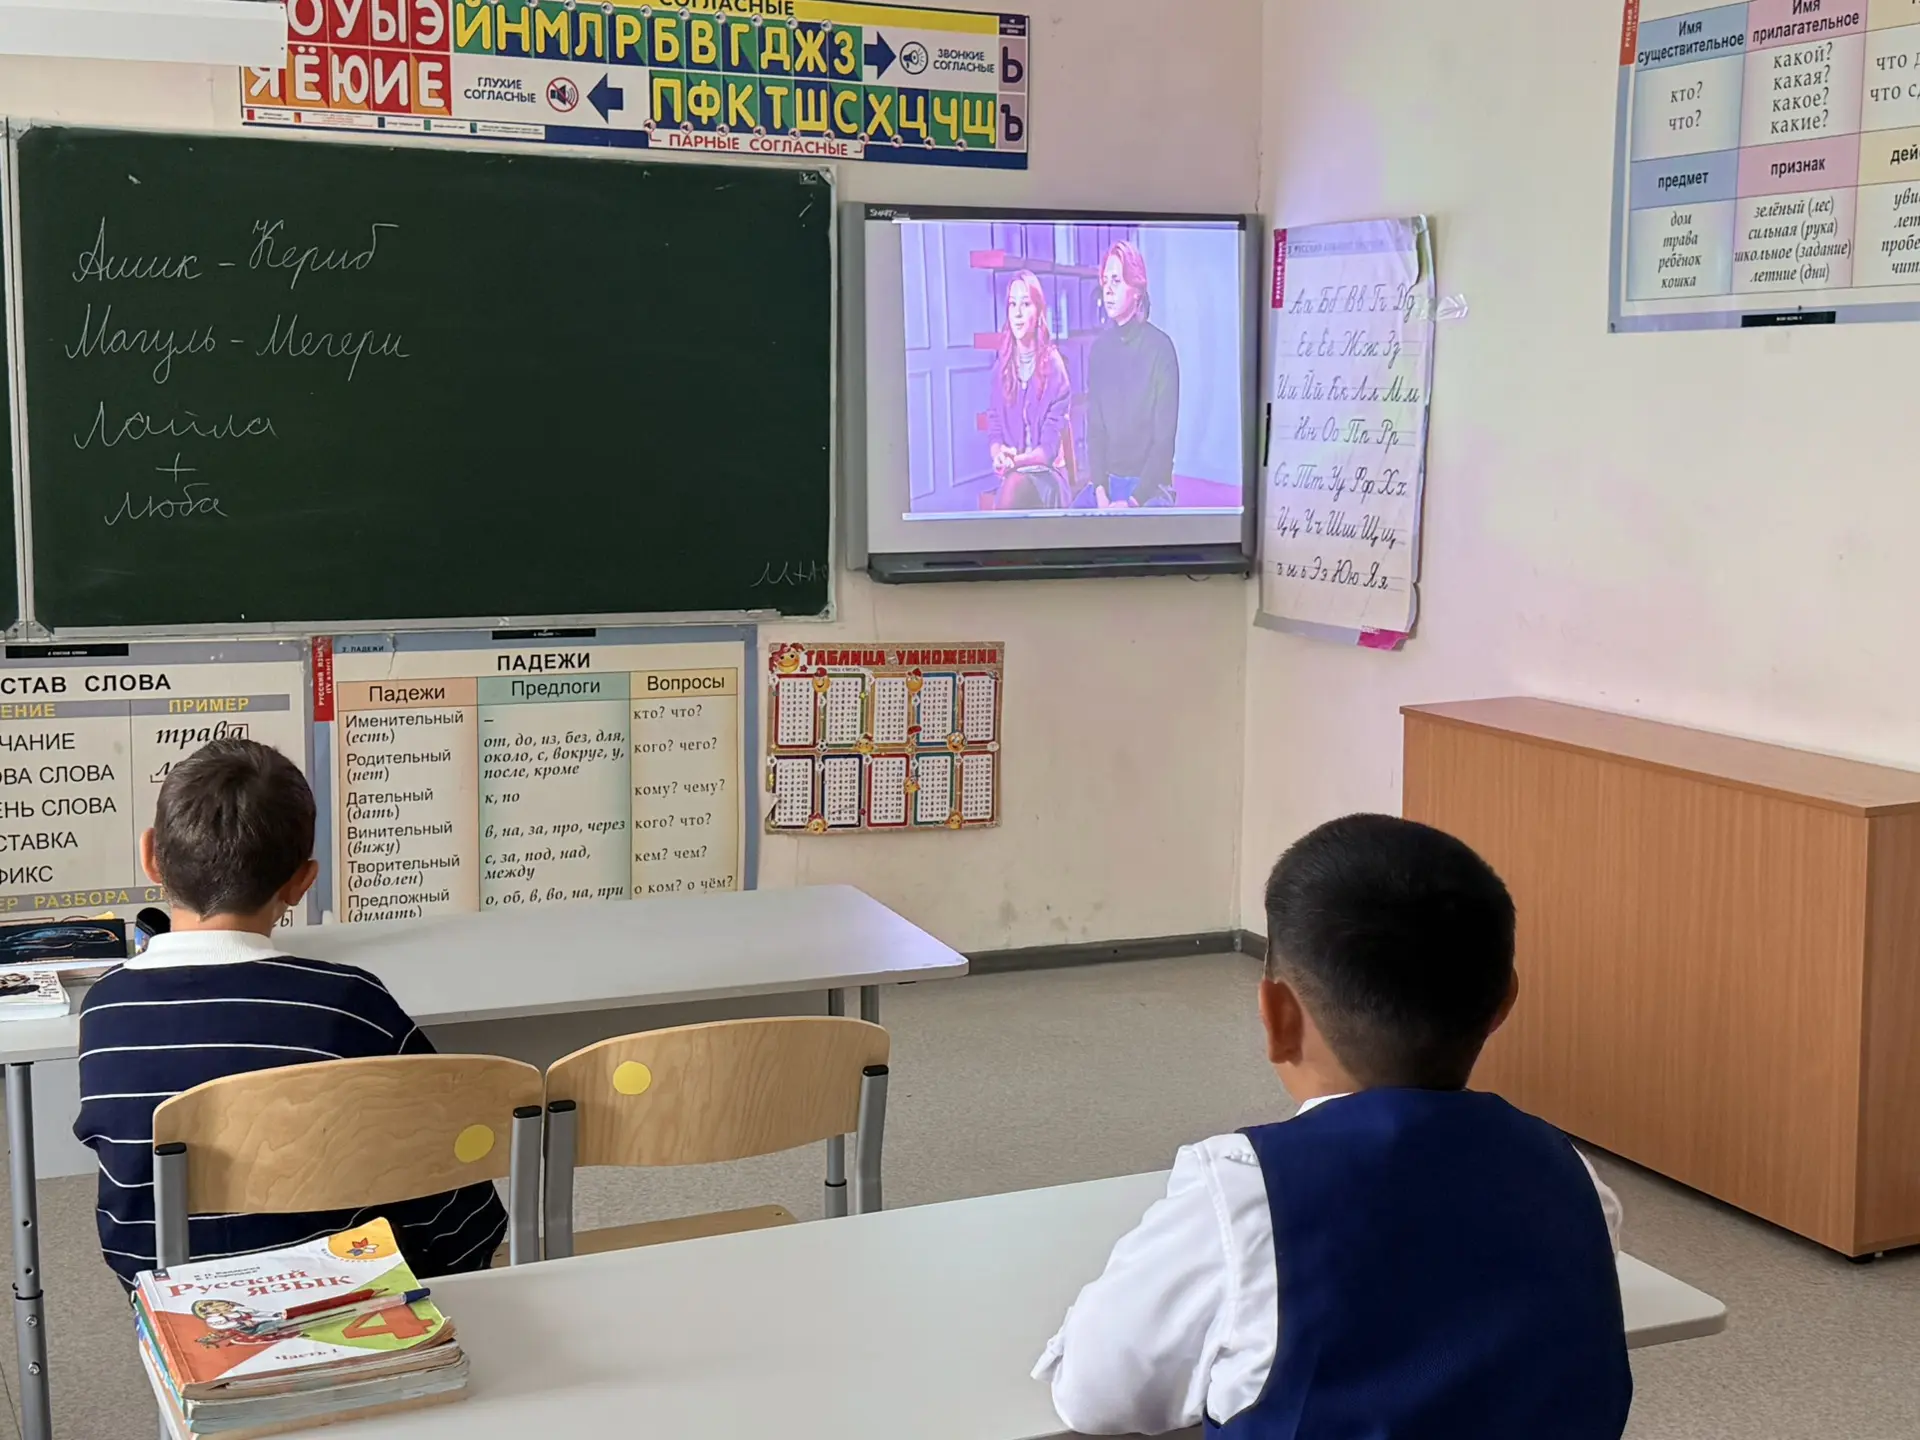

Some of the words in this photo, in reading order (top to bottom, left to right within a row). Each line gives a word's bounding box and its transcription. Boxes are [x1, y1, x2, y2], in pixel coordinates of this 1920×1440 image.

[1792, 0, 1821, 15] Имя
[1678, 19, 1703, 37] Имя
[1752, 11, 1860, 43] прилагательное
[937, 48, 986, 62] ЗВОНКИЕ
[1637, 33, 1745, 63] существительное
[1773, 42, 1833, 69] какой?
[933, 60, 995, 74] СОГЛАСНЫЕ
[1002, 46, 1024, 83] Ь
[1876, 54, 1908, 71] что
[477, 76, 523, 90] ГЛУХИЕ
[1773, 65, 1831, 91] какая?
[463, 88, 537, 104] СОГЛАСНЫЕ
[1670, 81, 1703, 104] кто?
[1772, 87, 1829, 112] какое?
[1870, 85, 1901, 102] что
[1000, 104, 1024, 141] Ъ
[1668, 110, 1702, 131] что?
[1770, 109, 1829, 135] какие?
[669, 133, 741, 151] ПАРНЫЕ
[749, 138, 849, 156] СОГЛАСНЫЕ
[1890, 143, 1920, 165] дей
[1770, 157, 1826, 177] признак
[1657, 171, 1709, 191] предмет
[1753, 200, 1804, 219] зелёный
[1807, 196, 1834, 217] (лес)
[1670, 210, 1692, 227] дом
[1748, 223, 1797, 241] сильная
[1801, 217, 1838, 240] (рука)
[1663, 231, 1698, 251] трава
[1734, 249, 1792, 263] школьное
[1794, 239, 1852, 263] (задание)
[72, 216, 203, 282] Ашик
[249, 218, 400, 290] Кериб
[1657, 253, 1702, 273] ребёнок
[1661, 274, 1697, 290] кошка
[1750, 269, 1797, 284] летние
[1799, 263, 1830, 284] (дни)
[65, 303, 216, 384] Магуль
[256, 314, 410, 382] Мегери
[73, 401, 279, 449] Лайла
[497, 652, 590, 672] ПАДЕЖИ
[805, 649, 886, 666] ТАБЛИЦА
[84, 673, 172, 692] СЛОВА
[511, 680, 601, 700] Предлоги
[647, 675, 725, 694] Вопросы
[369, 685, 446, 703] Падежи
[168, 697, 250, 713] ПРИМЕР
[633, 705, 665, 720] кто?
[671, 704, 702, 718] что?
[346, 711, 464, 728] Именительный
[156, 720, 245, 749] трава
[346, 729, 395, 746] (есть)
[634, 739, 674, 754] кого?
[679, 737, 717, 751] чего?
[346, 749, 451, 768] Родительный
[39, 764, 115, 784] СЛОВА
[346, 766, 389, 784] (нет)
[346, 788, 434, 808] Дательный
[634, 782, 678, 798] кому?
[683, 779, 726, 795] чему?
[41, 797, 117, 816] СЛОВА
[346, 805, 400, 822] (дать)
[347, 821, 453, 840] Винительный
[635, 815, 674, 829] кого?
[680, 813, 712, 826] что?
[347, 839, 400, 857] (вижу)
[634, 848, 668, 862] кем?
[674, 845, 708, 859] чем?
[347, 854, 460, 875] Творительный
[348, 873, 424, 891] (доволен)
[634, 885, 642, 894] о
[648, 879, 682, 893] ком?
[687, 882, 695, 890] о
[700, 875, 733, 890] чём?
[34, 890, 130, 909] РАЗБОРА
[348, 889, 450, 909] Предложный
[165, 1269, 309, 1298] Русский
[341, 1302, 437, 1340] 4
